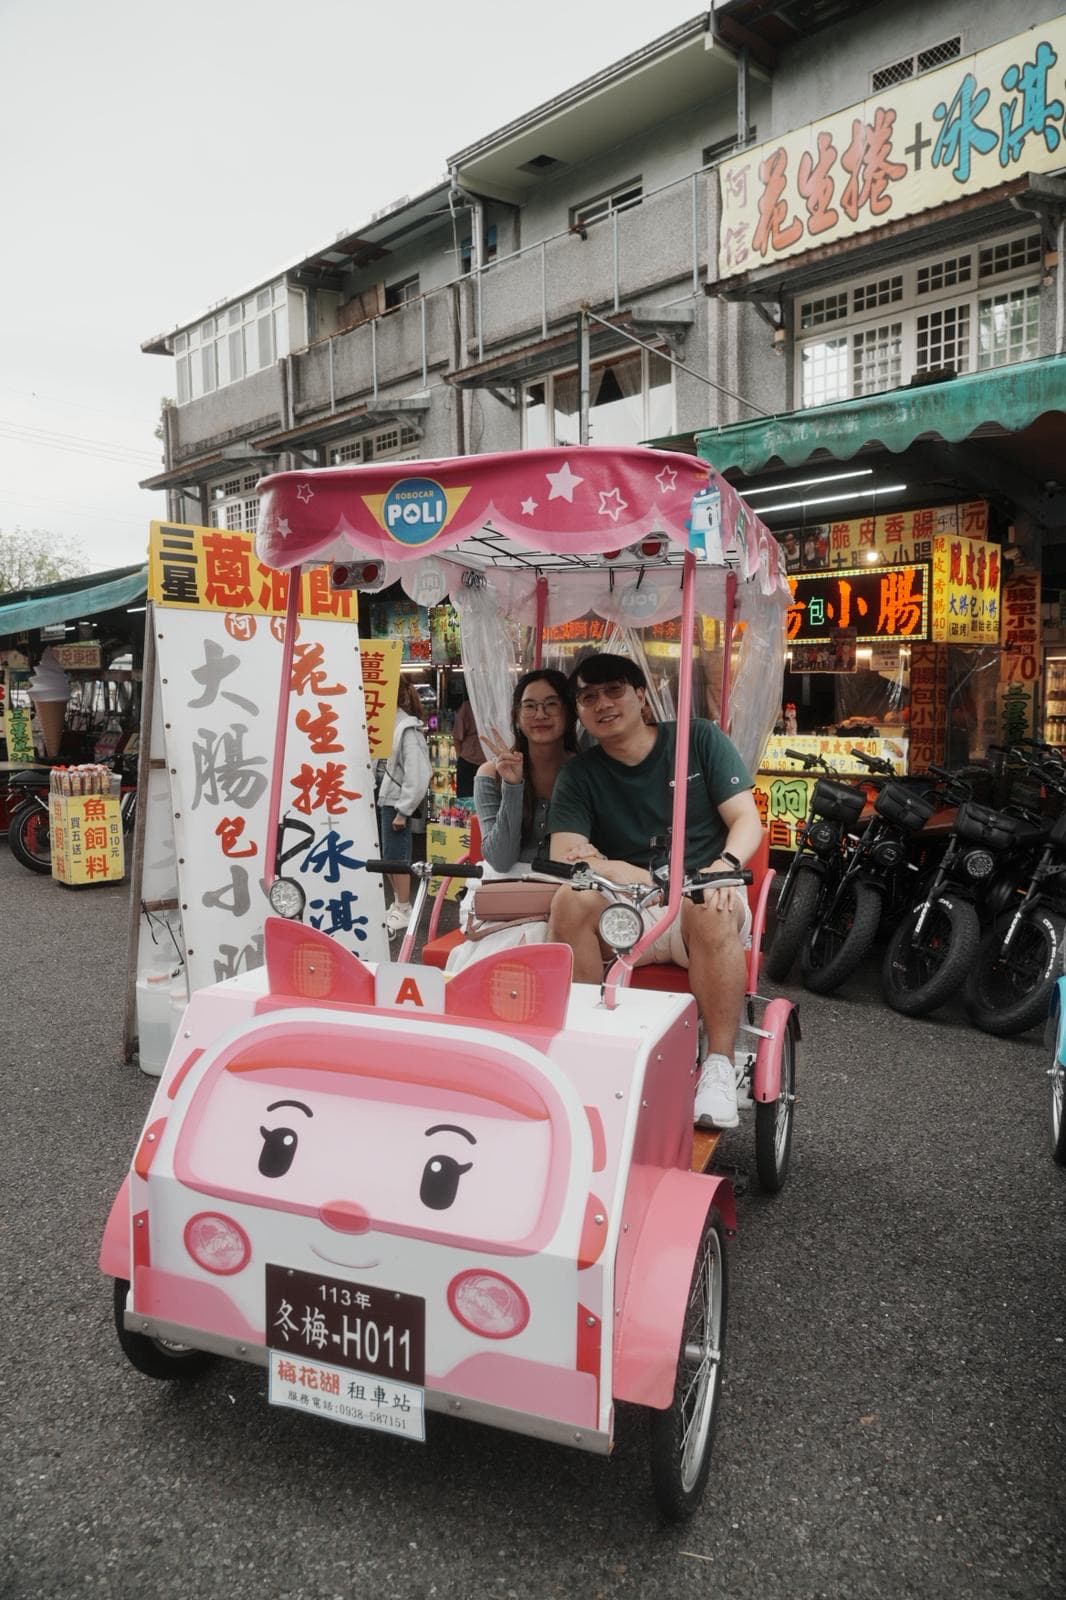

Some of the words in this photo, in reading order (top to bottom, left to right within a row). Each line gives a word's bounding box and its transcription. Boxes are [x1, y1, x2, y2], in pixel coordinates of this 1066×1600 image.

[752, 41, 1066, 257] 花生捲+冰淇
[388, 501, 442, 526] POLI
[395, 490, 434, 500] ROBOCAR
[159, 526, 200, 604] 三星
[83, 798, 109, 879] 魚飼料
[394, 977, 424, 1007] A
[318, 1284, 371, 1310] 113年
[272, 1298, 410, 1373] 冬梅-H011
[277, 1359, 340, 1396] 梅花湖
[347, 1381, 410, 1414] 租車站
